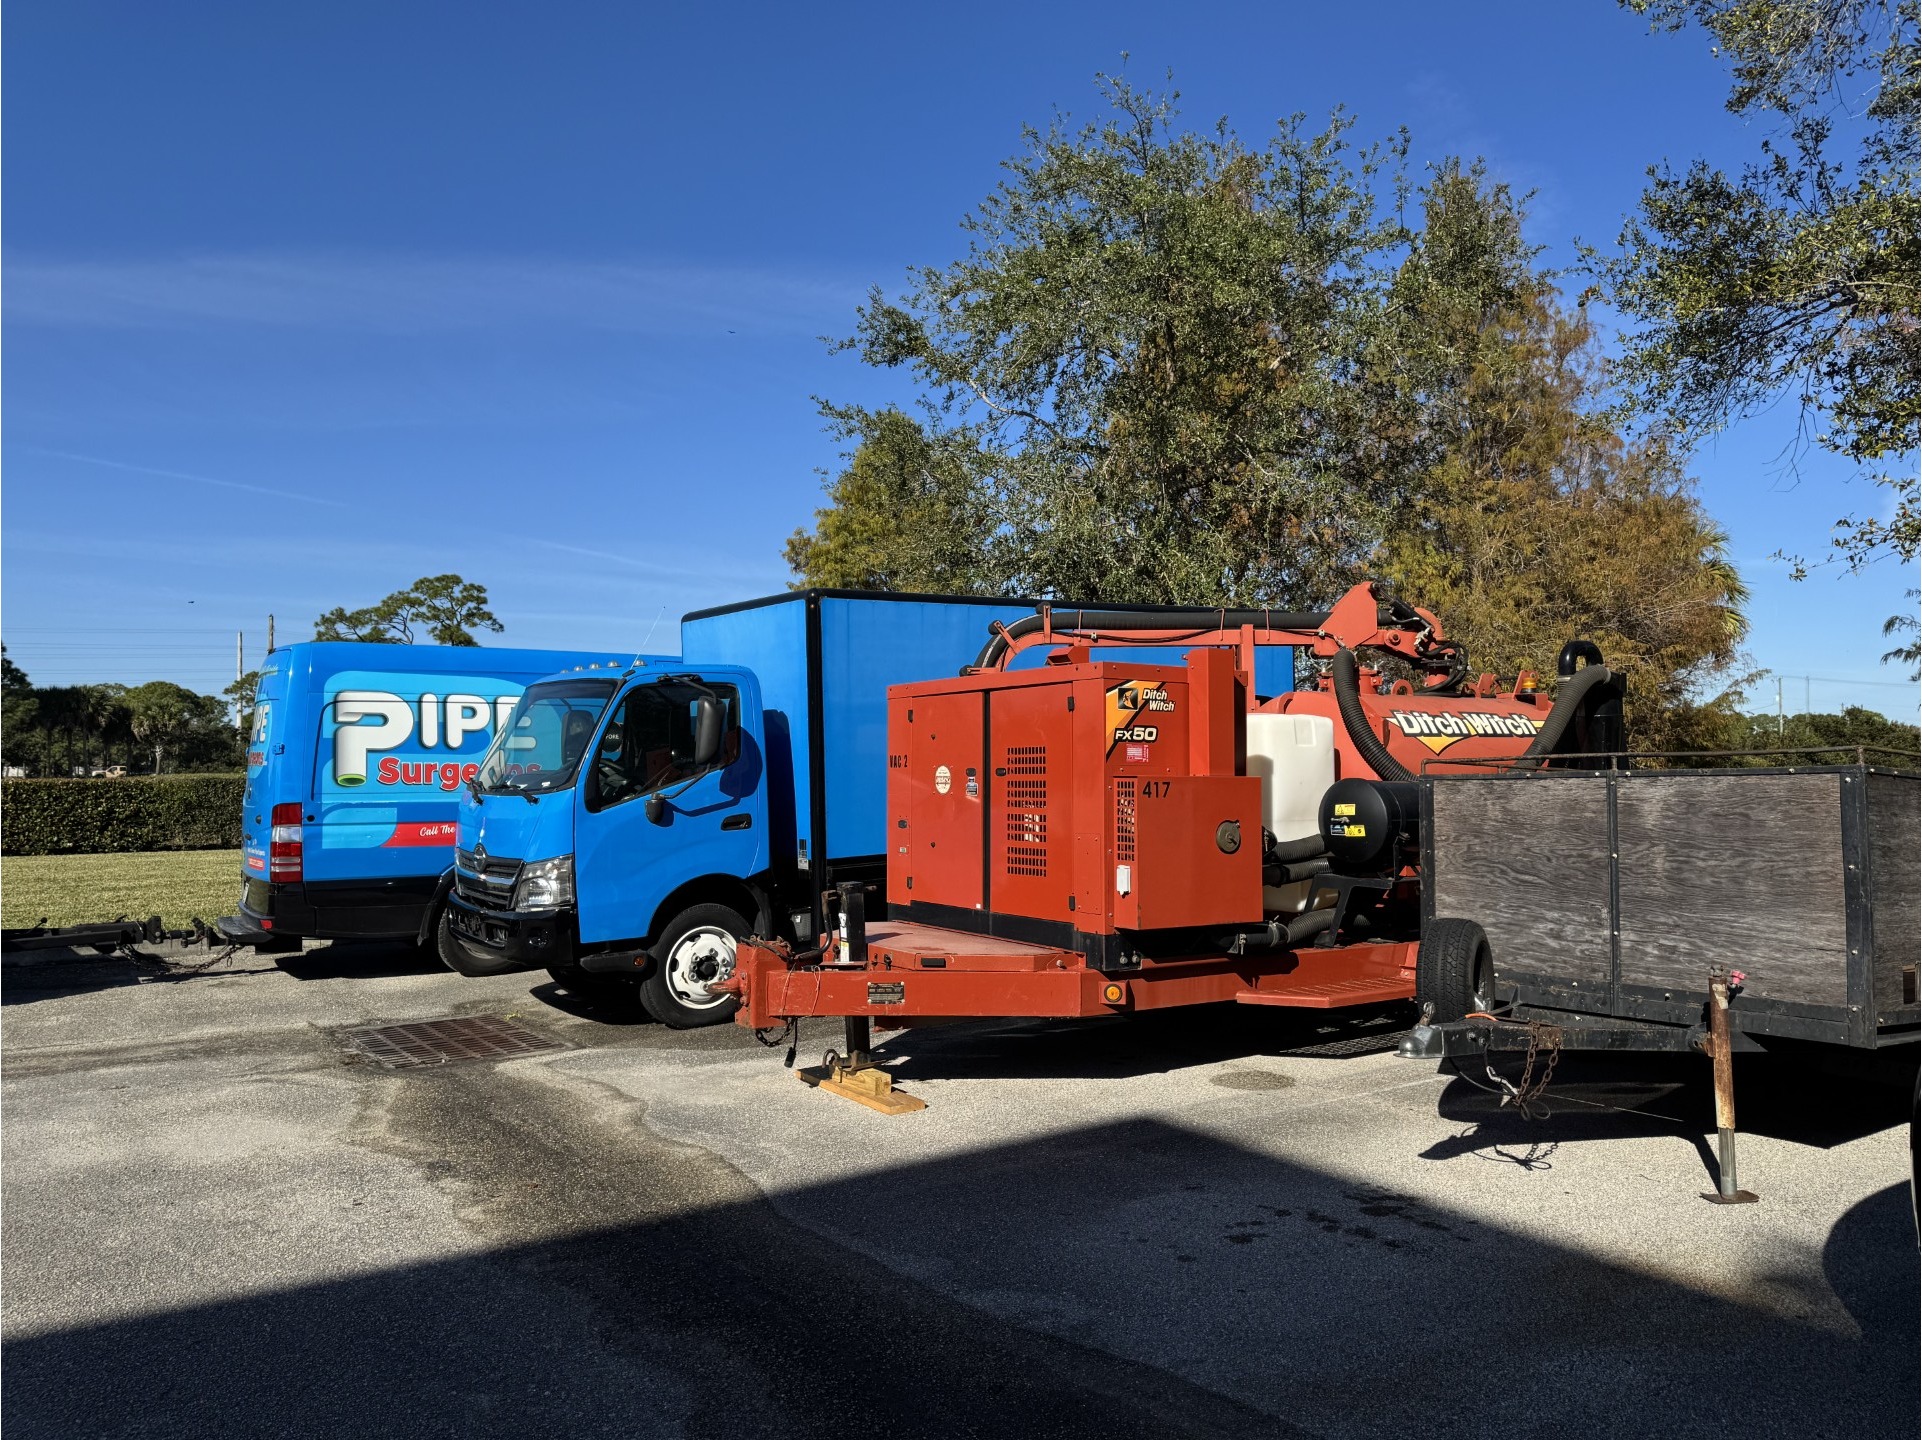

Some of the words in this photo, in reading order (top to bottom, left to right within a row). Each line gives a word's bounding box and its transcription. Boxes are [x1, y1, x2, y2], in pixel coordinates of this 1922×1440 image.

[1143, 689, 1167, 700] Ditch
[1149, 700, 1174, 711] Witch
[1394, 710, 1468, 735] Ditch
[1462, 712, 1538, 735] Witch
[336, 690, 537, 787] PIPE
[1115, 727, 1157, 741] FX50
[889, 754, 902, 768] VAC
[903, 754, 908, 768] 2
[1142, 781, 1171, 798] 417
[419, 825, 439, 837] Call
[440, 824, 456, 835] The
